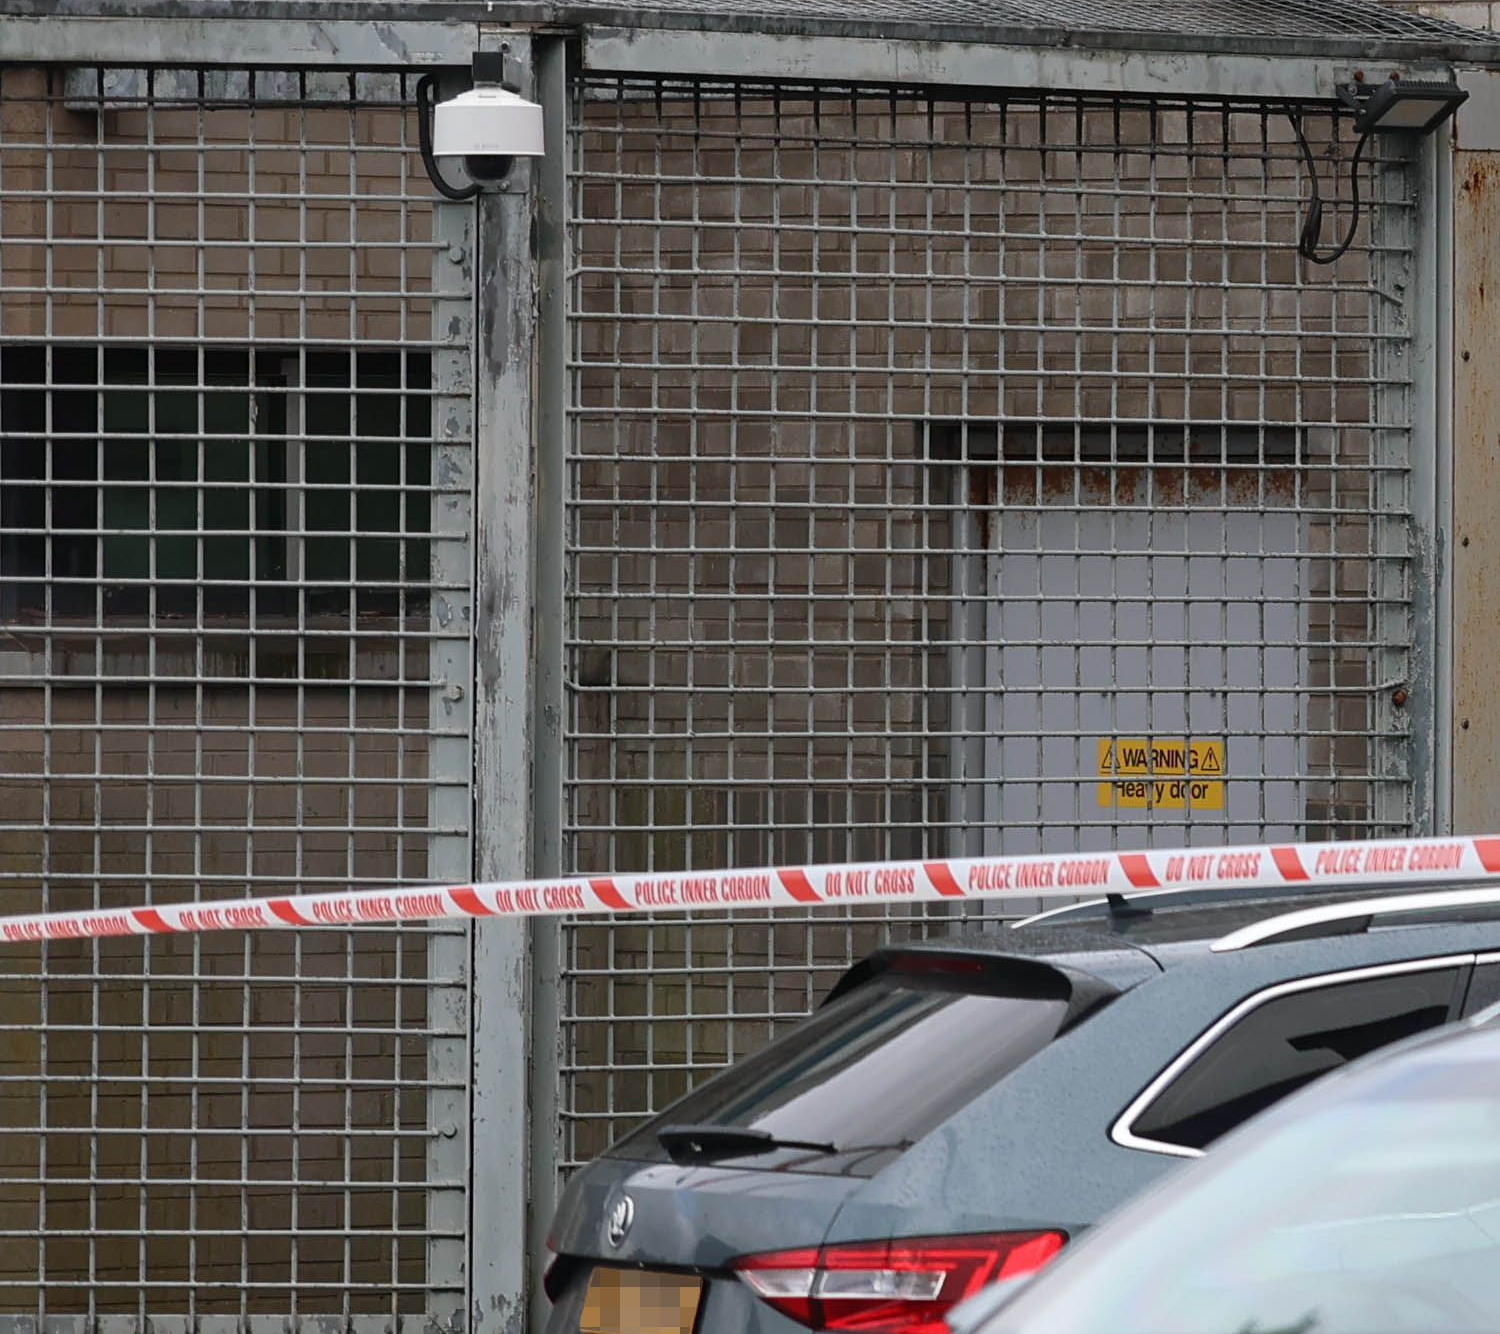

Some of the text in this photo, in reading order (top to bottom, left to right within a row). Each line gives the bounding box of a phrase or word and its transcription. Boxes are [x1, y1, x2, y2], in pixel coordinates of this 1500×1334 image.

[1123, 748, 1198, 769] WARNING
[1166, 853, 1261, 881] DO NOT CROSS
[1314, 845, 1464, 874] POLICE INNER CORDON
[825, 869, 915, 896] DO NOT CROSS
[968, 861, 1111, 890] POLICE INNER CORDON
[495, 886, 584, 916] DO NOT CROSS
[635, 876, 771, 908] POLICE INNER CORDON
[179, 903, 268, 931] DO NOT CROSS
[312, 895, 446, 925] POLICE INNER CORDON
[45, 920, 80, 939] INNER
[82, 913, 132, 938] CORDON
